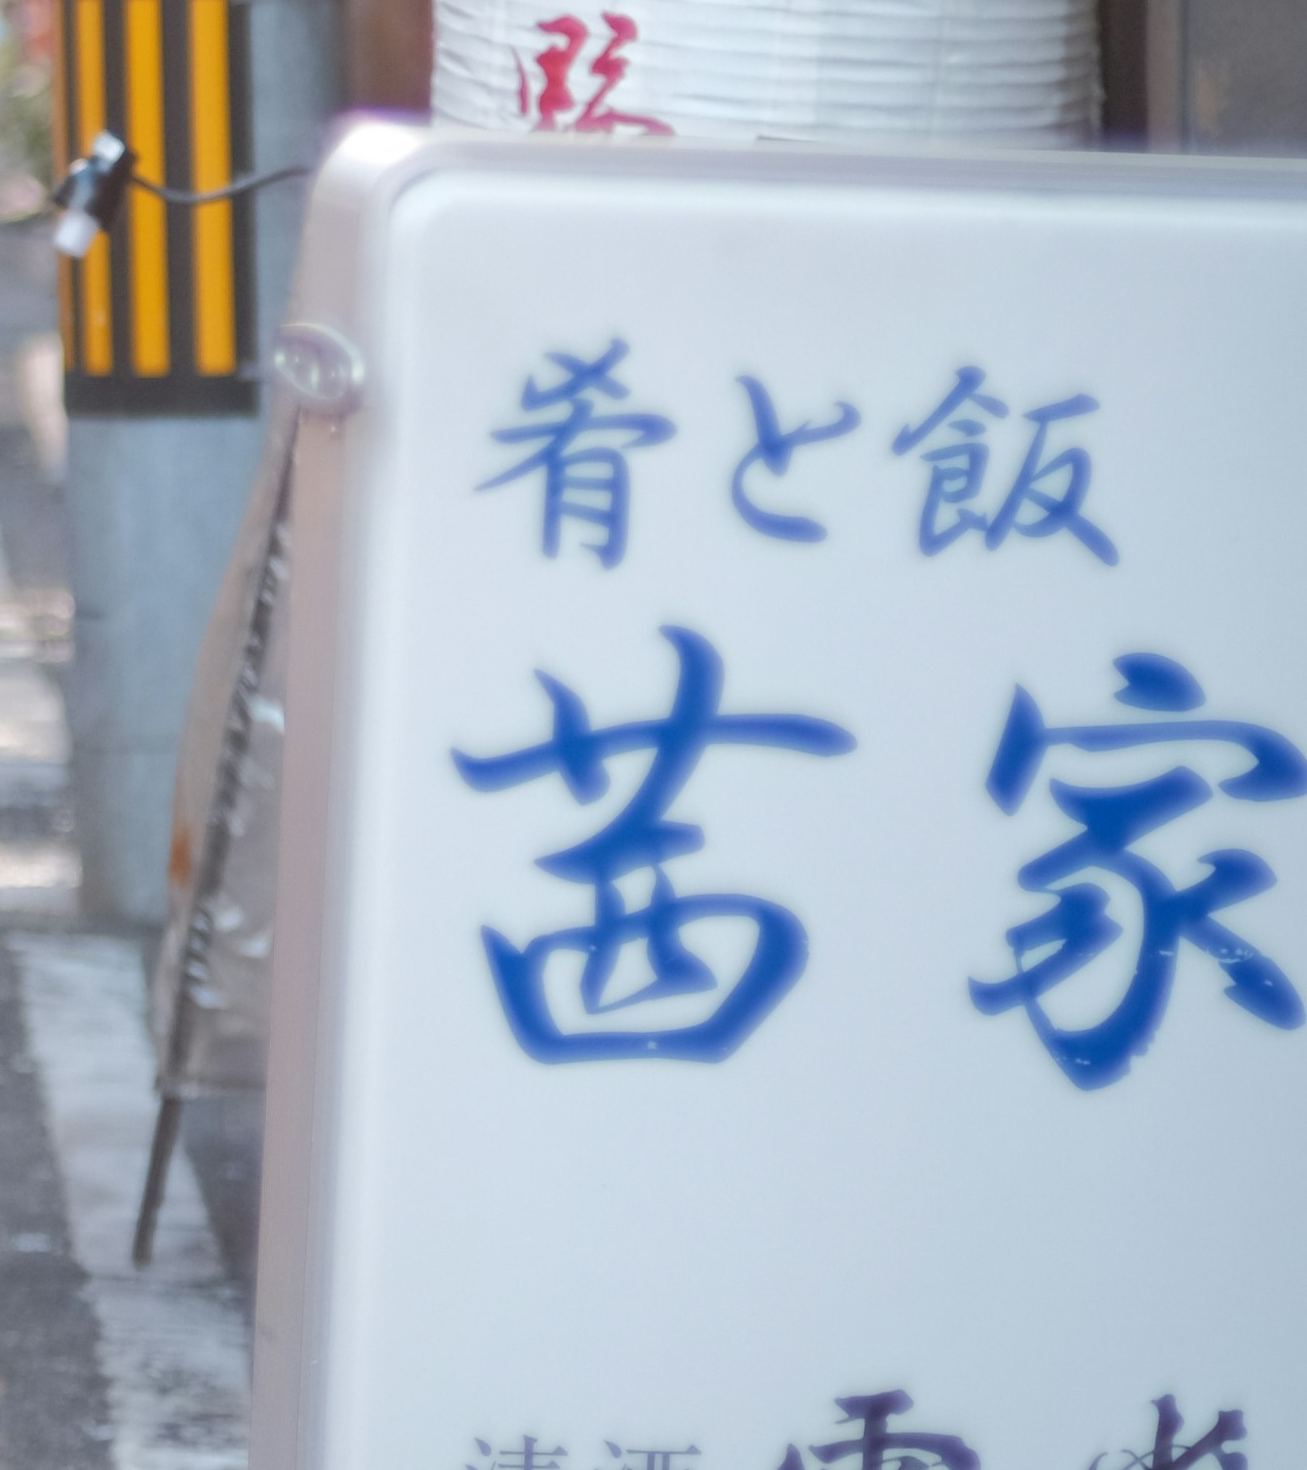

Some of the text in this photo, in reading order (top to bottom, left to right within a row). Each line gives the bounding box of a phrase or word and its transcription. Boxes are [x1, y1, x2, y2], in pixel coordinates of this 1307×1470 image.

[475, 337, 1121, 569] 肴と飯
[450, 622, 1307, 1093] 茜家
